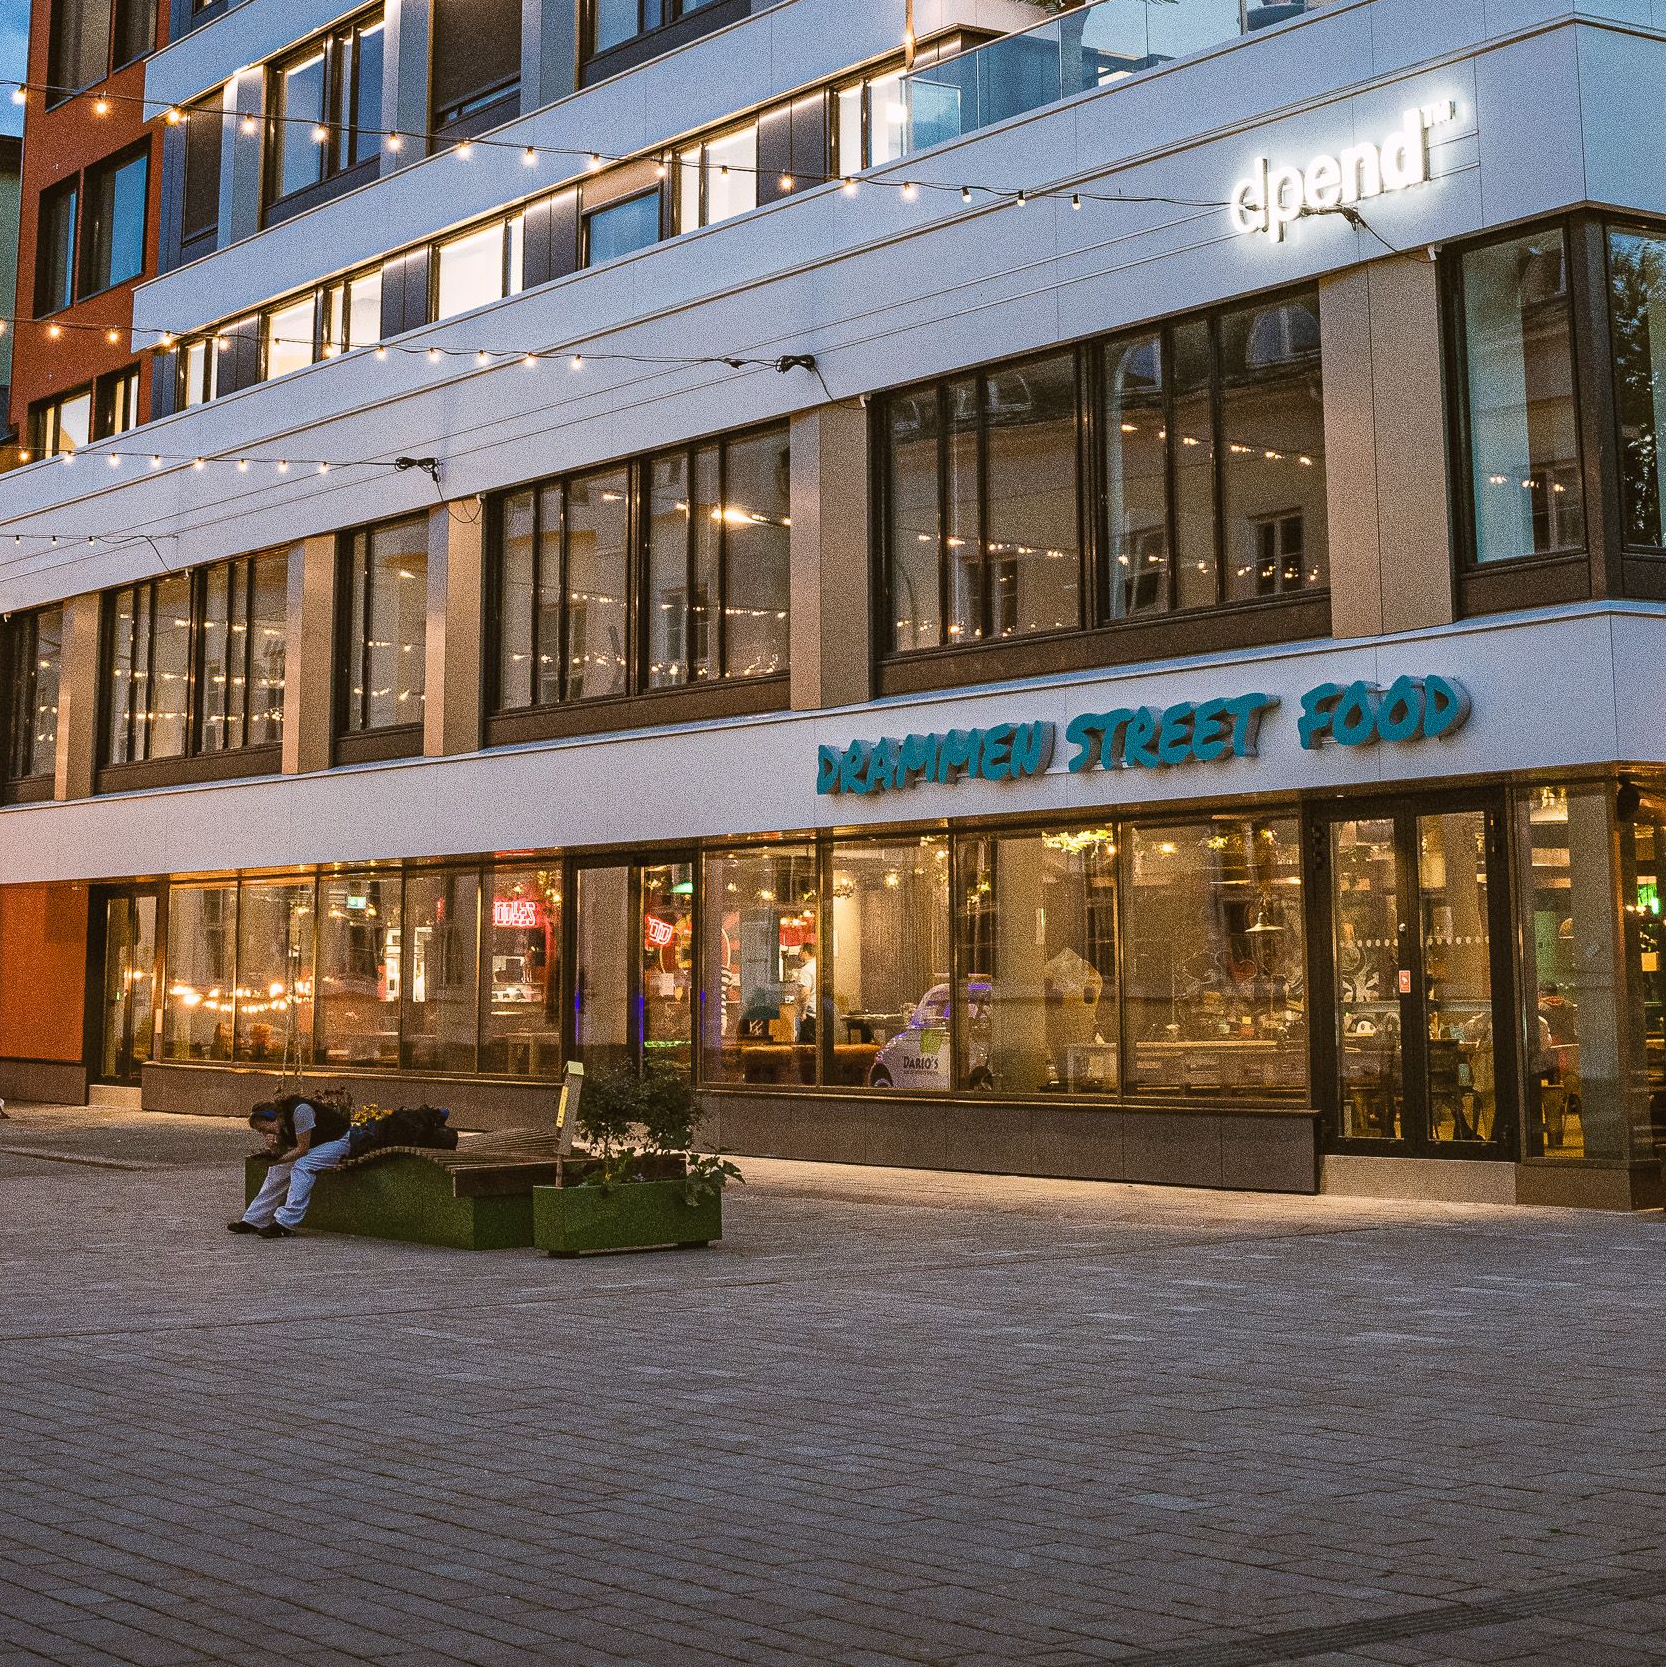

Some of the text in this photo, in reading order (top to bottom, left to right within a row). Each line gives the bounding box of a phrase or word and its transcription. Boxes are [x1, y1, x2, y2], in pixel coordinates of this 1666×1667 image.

[817, 675, 1472, 795] DRAMMEN STREET FOOD
